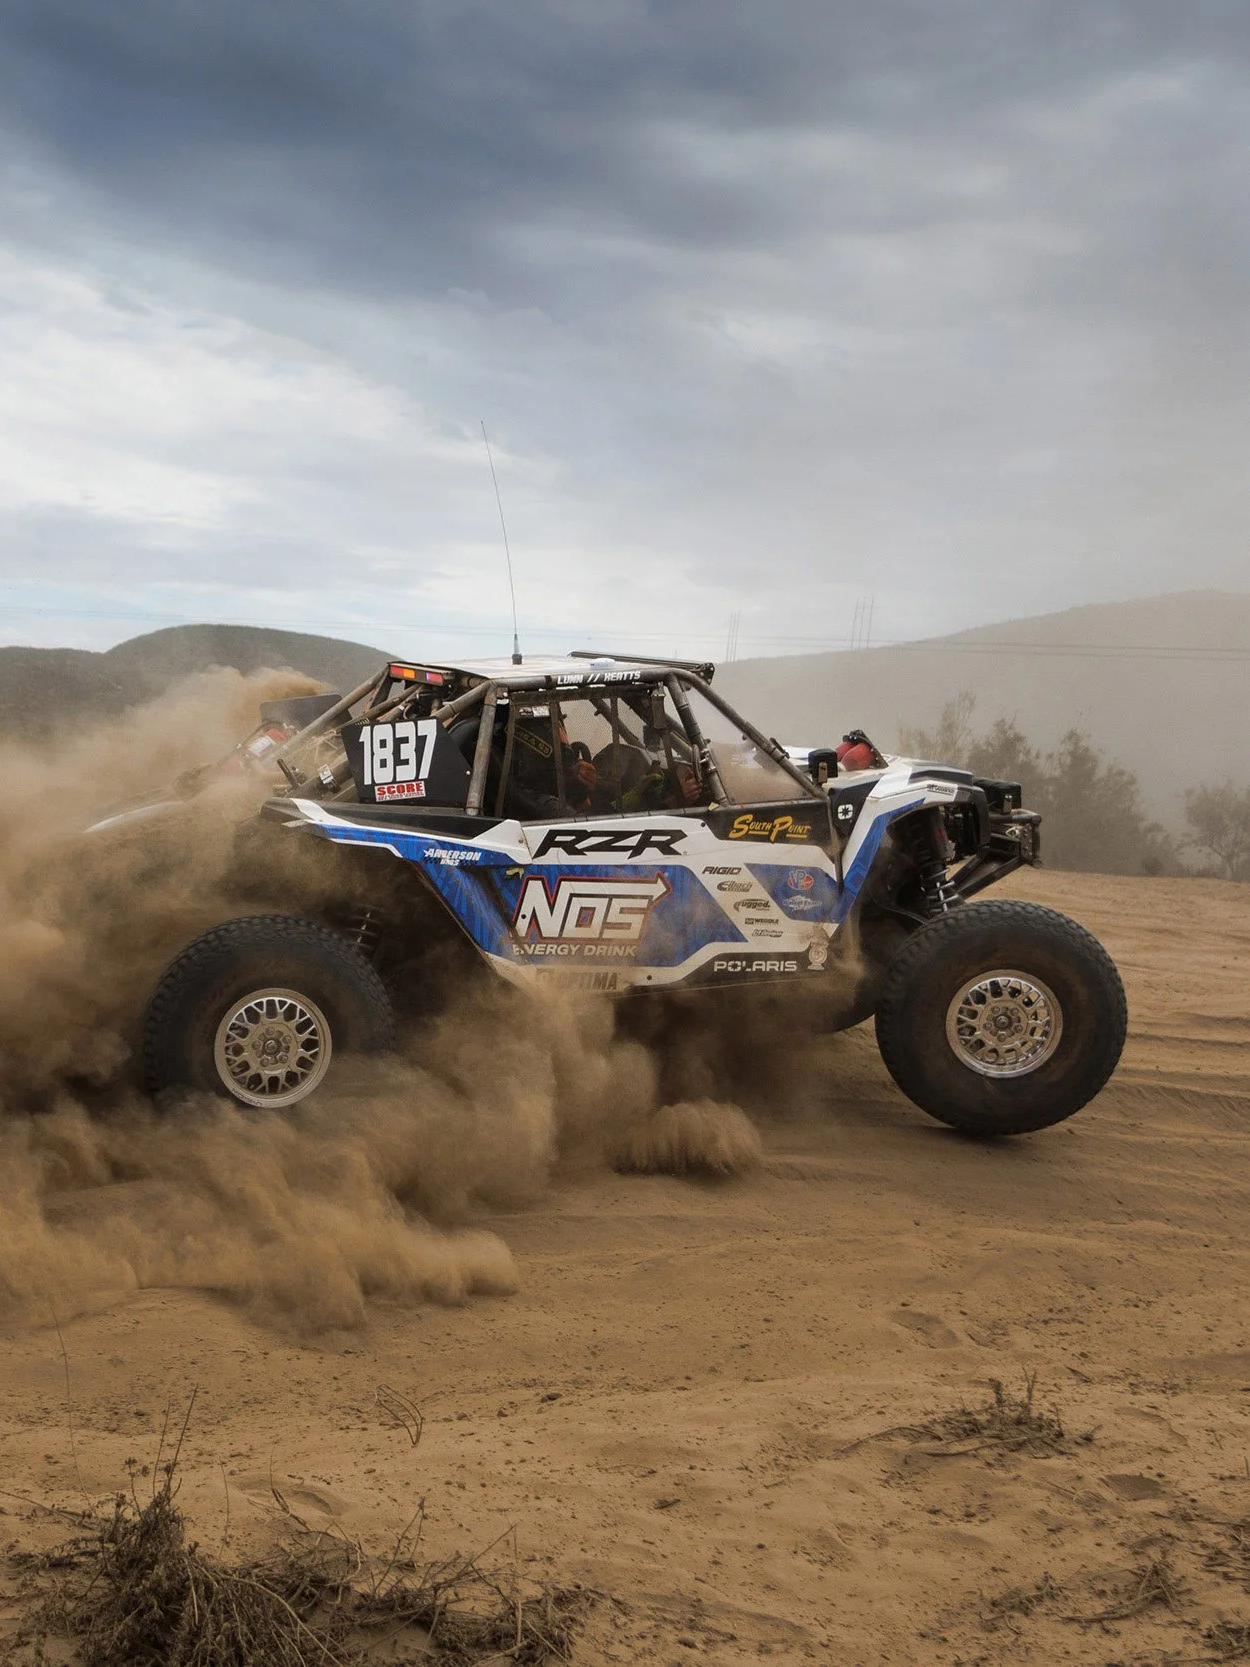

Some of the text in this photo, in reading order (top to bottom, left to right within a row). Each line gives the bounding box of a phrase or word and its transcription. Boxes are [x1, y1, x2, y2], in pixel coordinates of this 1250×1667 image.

[358, 719, 437, 786] 1837
[376, 782, 424, 796] SCORE
[532, 829, 688, 860] RZR
[702, 866, 742, 875] RIGID
[512, 875, 671, 941] NOS
[583, 945, 638, 957] DRINK
[713, 960, 798, 972] POLARIS
